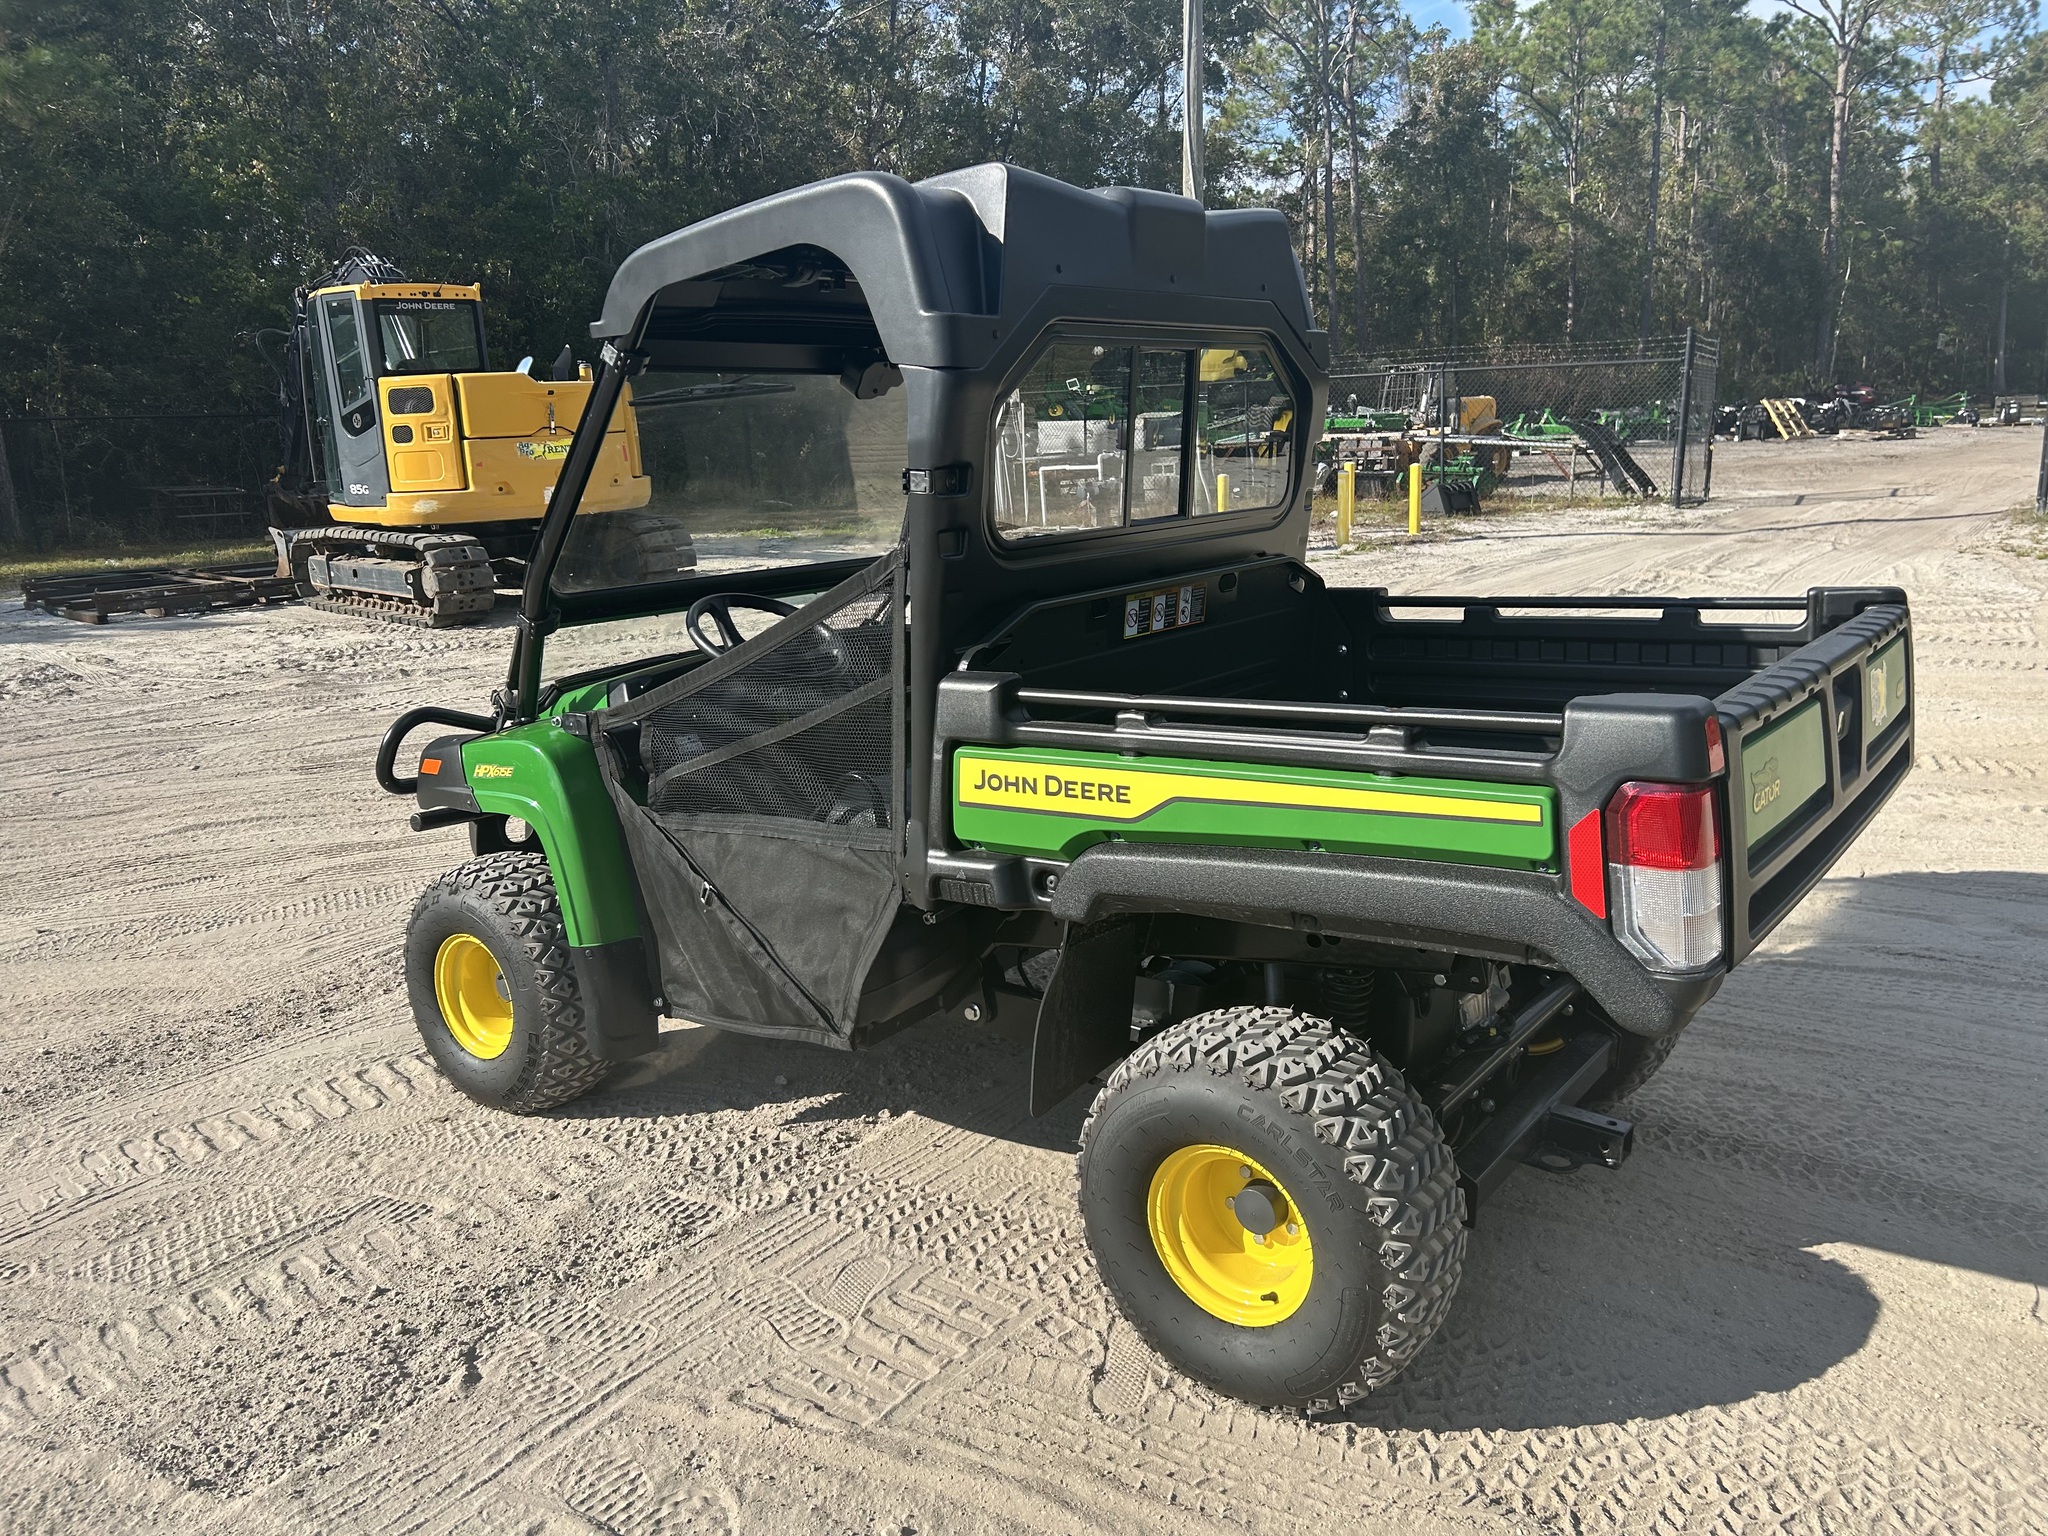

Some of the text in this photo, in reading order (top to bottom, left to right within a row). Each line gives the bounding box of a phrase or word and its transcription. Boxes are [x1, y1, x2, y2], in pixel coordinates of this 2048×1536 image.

[396, 301, 456, 310] JOHN DEERE
[349, 483, 370, 495] 85G
[973, 769, 1132, 804] JOHN DEERE
[1753, 778, 1781, 813] GATOR
[1236, 1103, 1345, 1213] CARLSTAR
